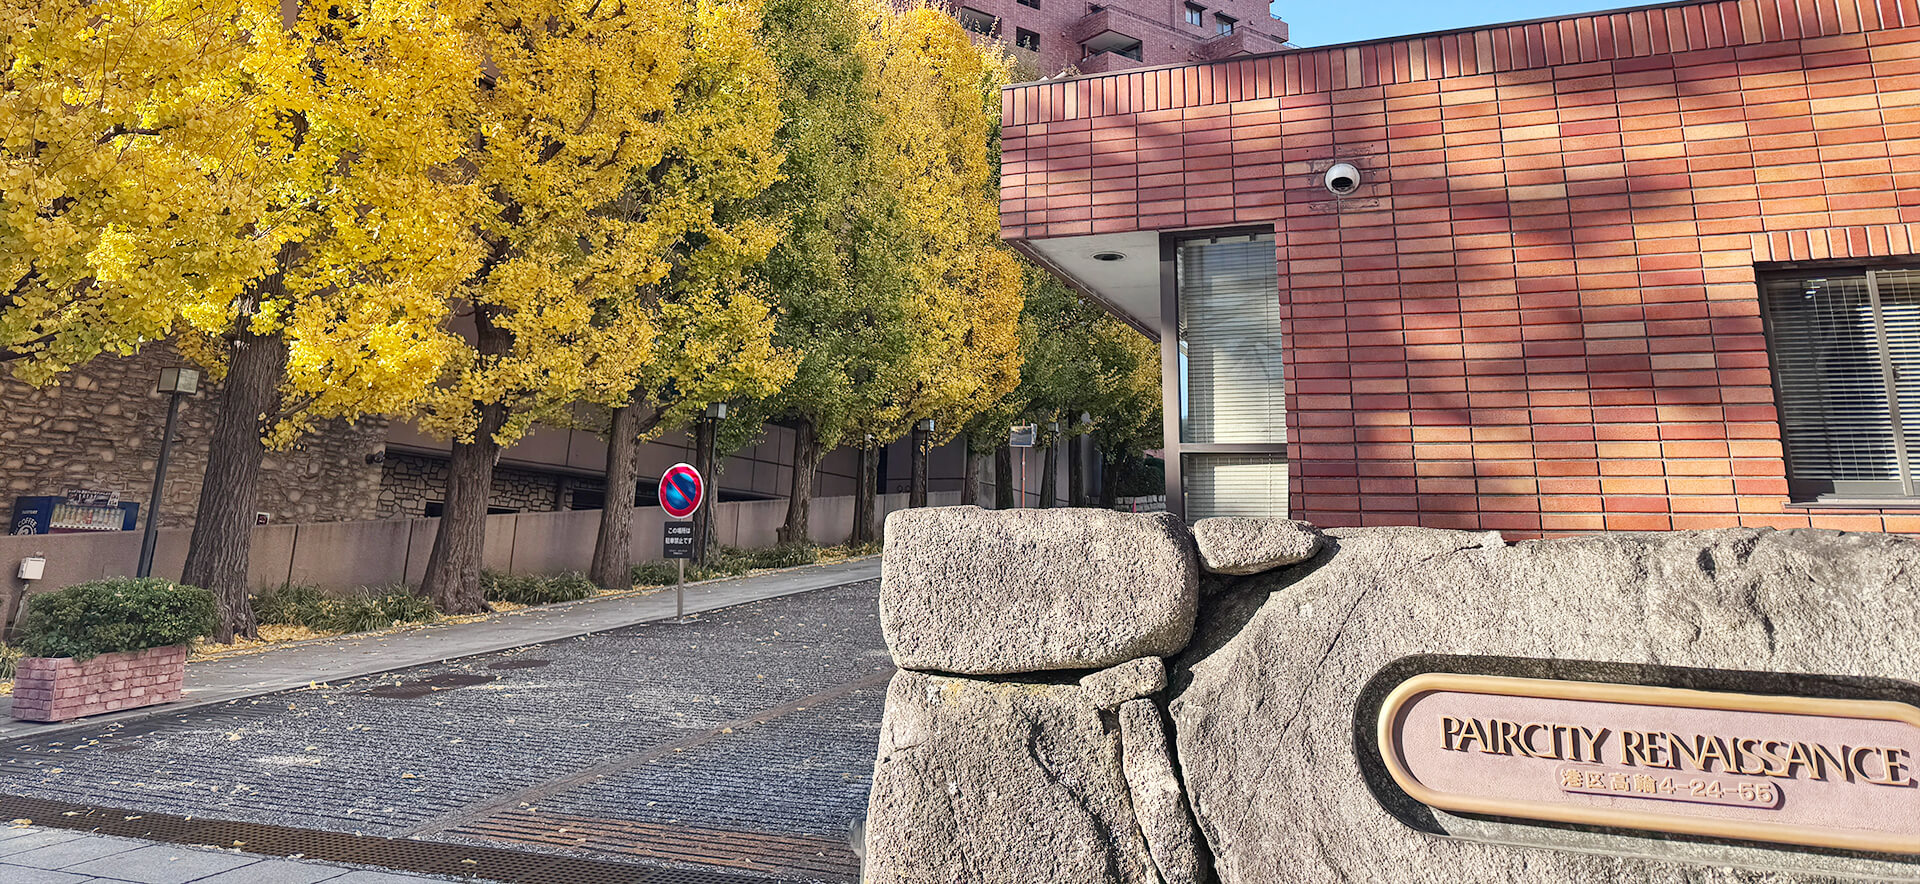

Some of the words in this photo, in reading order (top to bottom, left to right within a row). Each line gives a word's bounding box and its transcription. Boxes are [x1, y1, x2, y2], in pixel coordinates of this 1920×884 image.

[18, 517, 37, 528] COFFEE
[1440, 715, 1611, 763] PAIRCITY
[1619, 729, 1917, 787] RENAISSANCE
